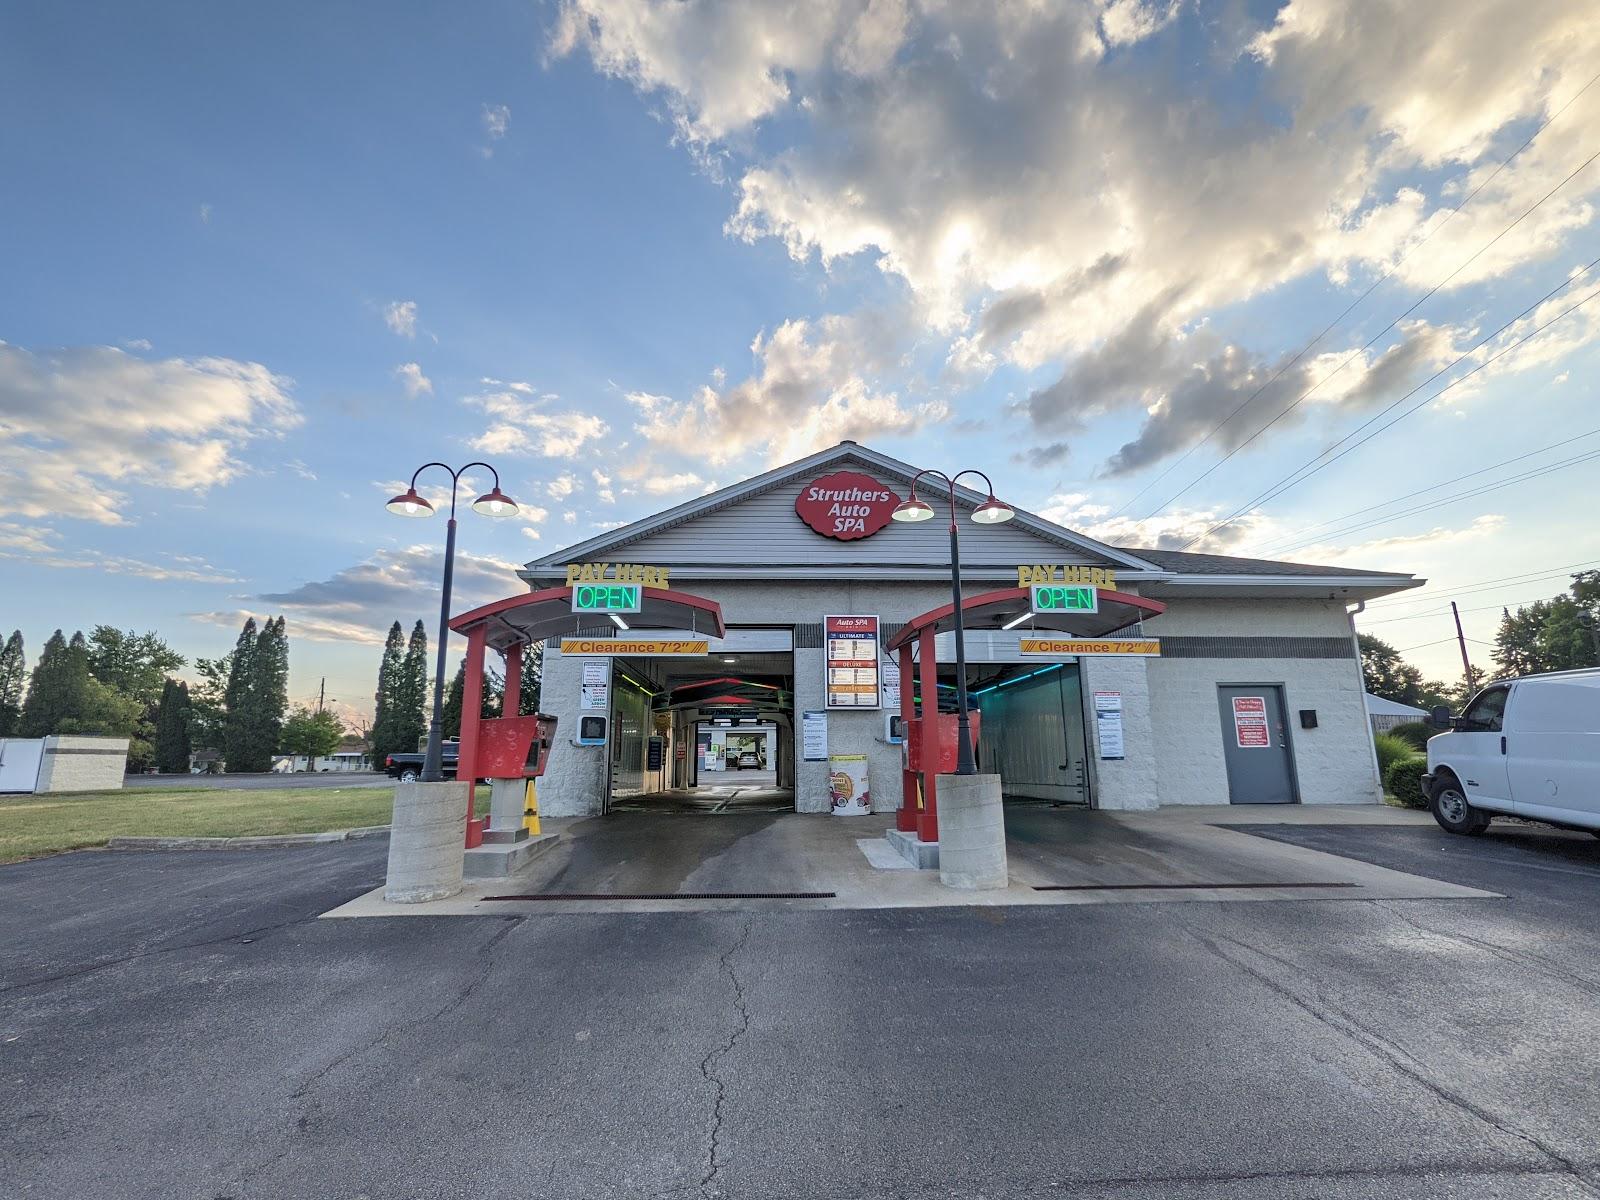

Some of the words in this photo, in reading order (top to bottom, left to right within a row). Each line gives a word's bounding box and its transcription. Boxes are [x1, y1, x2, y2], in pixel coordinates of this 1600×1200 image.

[807, 487, 890, 502] Struthers
[827, 503, 871, 517] Auto
[832, 518, 865, 532] SPA
[566, 563, 610, 584] PAY
[615, 563, 670, 588] HERE
[1017, 565, 1057, 586] PAY
[1063, 565, 1116, 589] HERE
[578, 586, 636, 609] OPEN
[1036, 587, 1093, 609] OPEN
[580, 642, 655, 653] Clearance
[659, 642, 690, 653] 7'2"
[1038, 642, 1110, 653] Clearance
[1113, 642, 1142, 653] 7'2"
